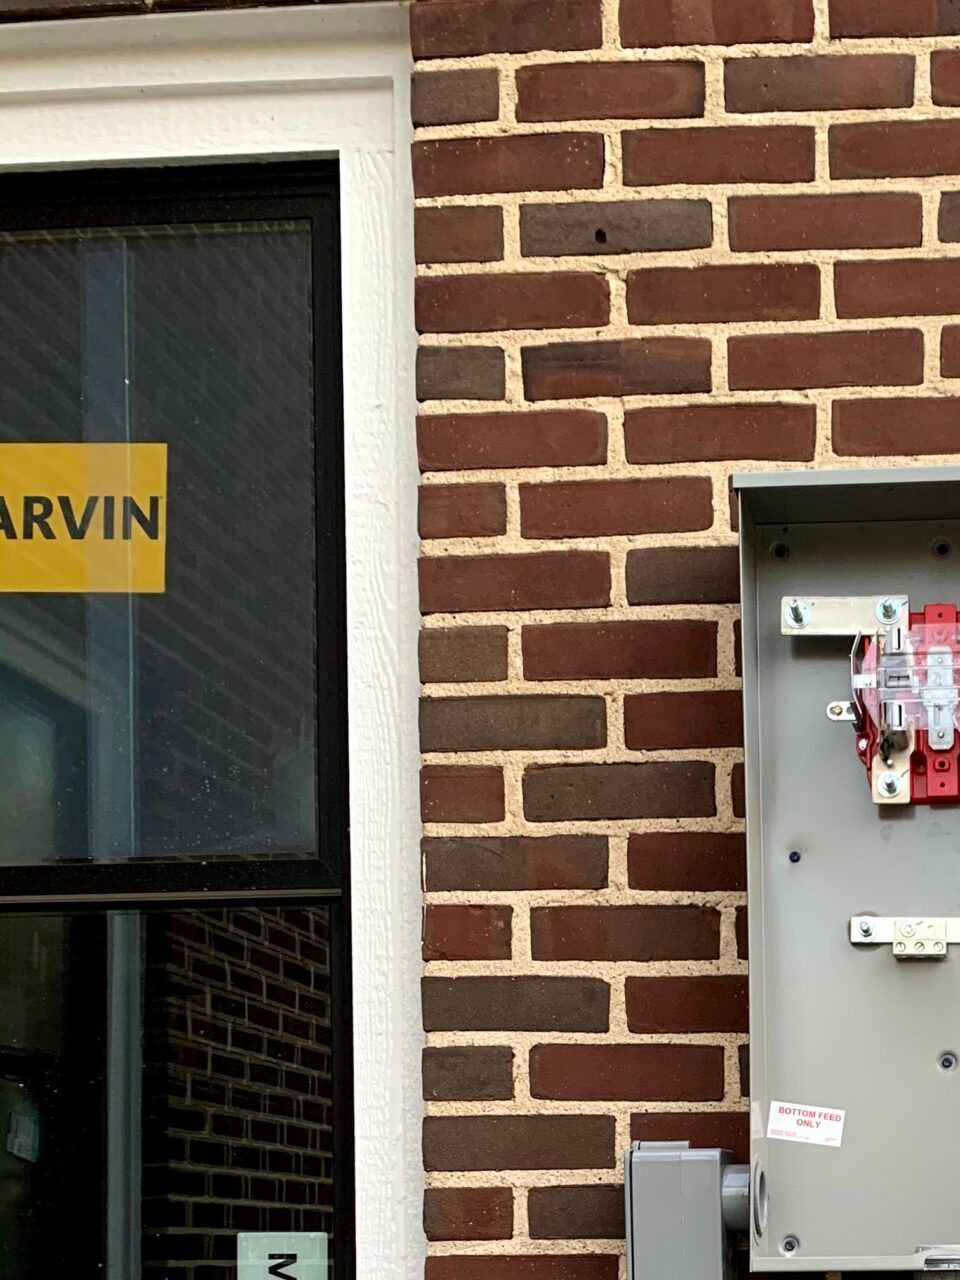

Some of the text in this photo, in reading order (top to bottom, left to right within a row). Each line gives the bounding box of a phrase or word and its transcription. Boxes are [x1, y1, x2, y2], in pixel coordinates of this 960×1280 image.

[778, 1106, 842, 1122] BOTTOM FEED
[796, 1118, 821, 1129] ONLY
